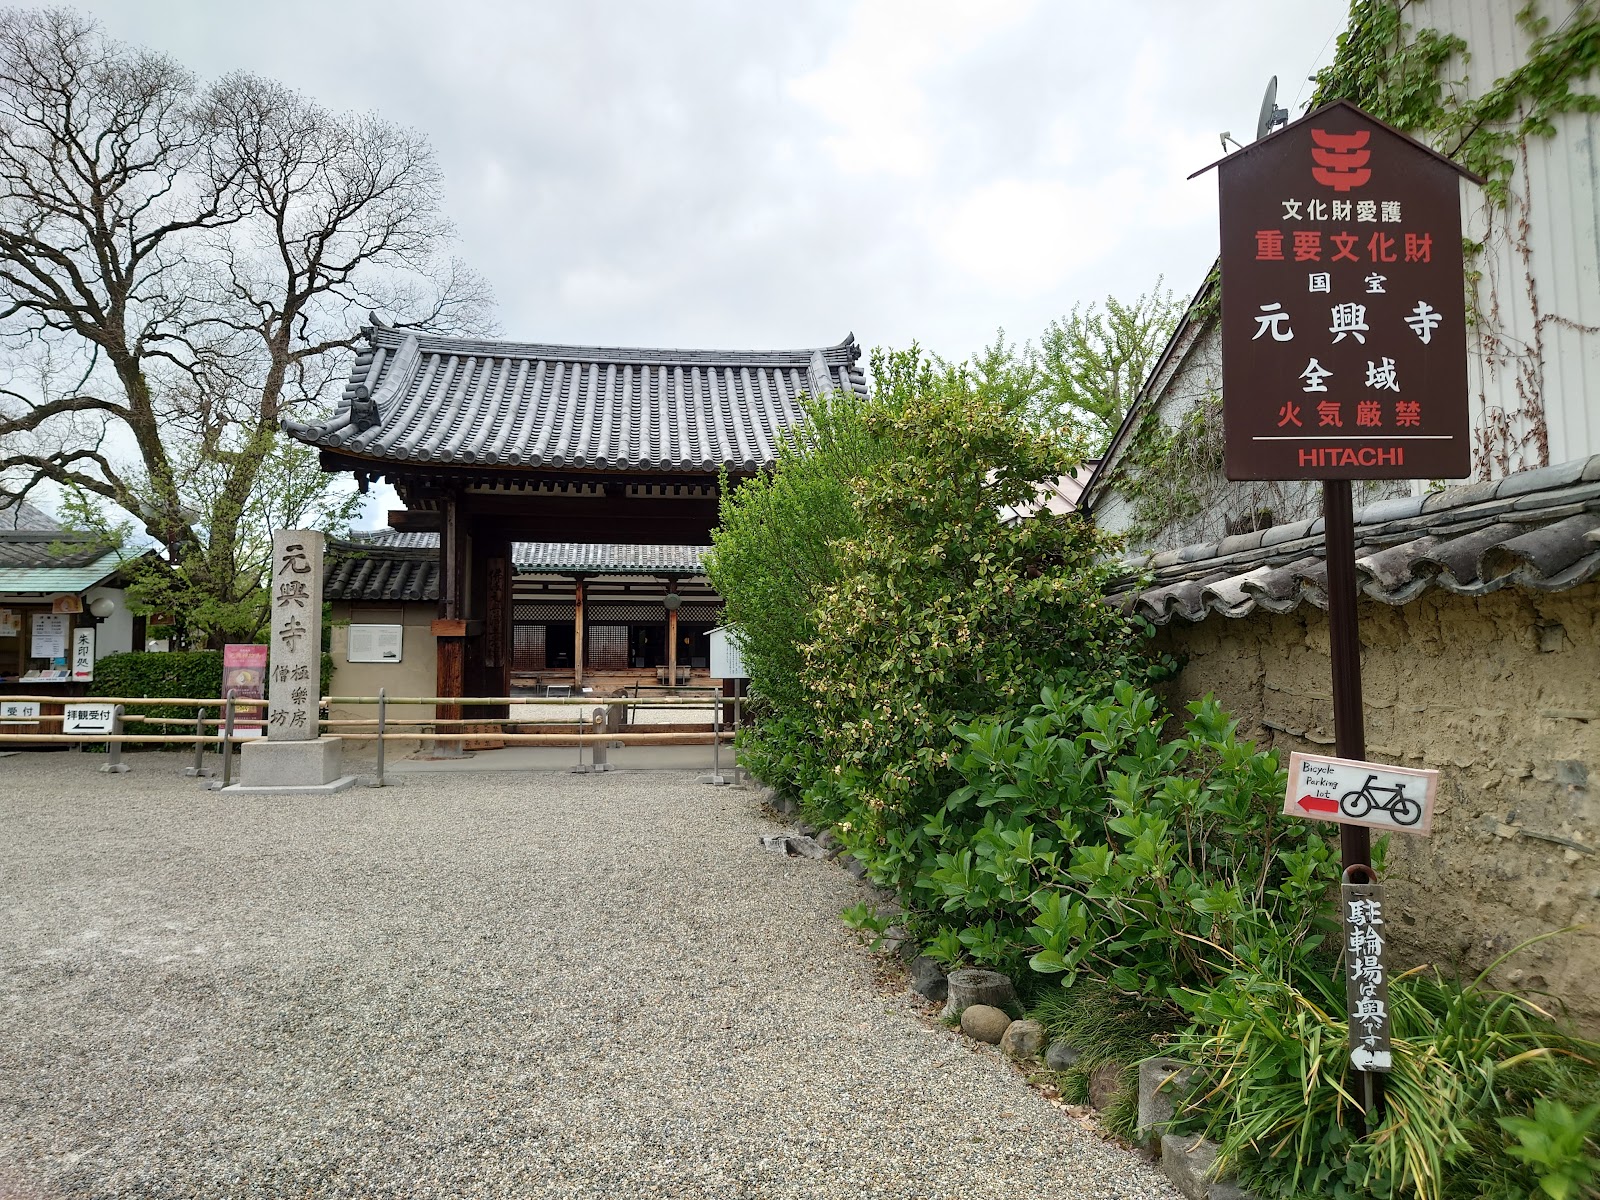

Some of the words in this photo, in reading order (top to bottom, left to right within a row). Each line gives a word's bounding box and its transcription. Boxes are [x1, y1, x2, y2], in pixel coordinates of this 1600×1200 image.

[1281, 198, 1402, 223] 文化財愛護
[1254, 229, 1433, 263] 重要文化財
[1307, 271, 1388, 294] 国宝
[1251, 302, 1443, 345] 元興寺
[1298, 357, 1401, 393] 全域
[1277, 400, 1422, 428] 火気厳禁
[1298, 447, 1404, 467] HITACHI
[276, 544, 312, 653] 元興寺
[76, 634, 90, 668] 朱印処
[7, 706, 33, 717] 受付
[67, 710, 111, 721] 拝観受付
[1302, 761, 1335, 775] Bicycle
[1306, 776, 1339, 790] Parking
[1316, 790, 1331, 799] lot
[1346, 898, 1388, 1048] 駐輪場は奥です
